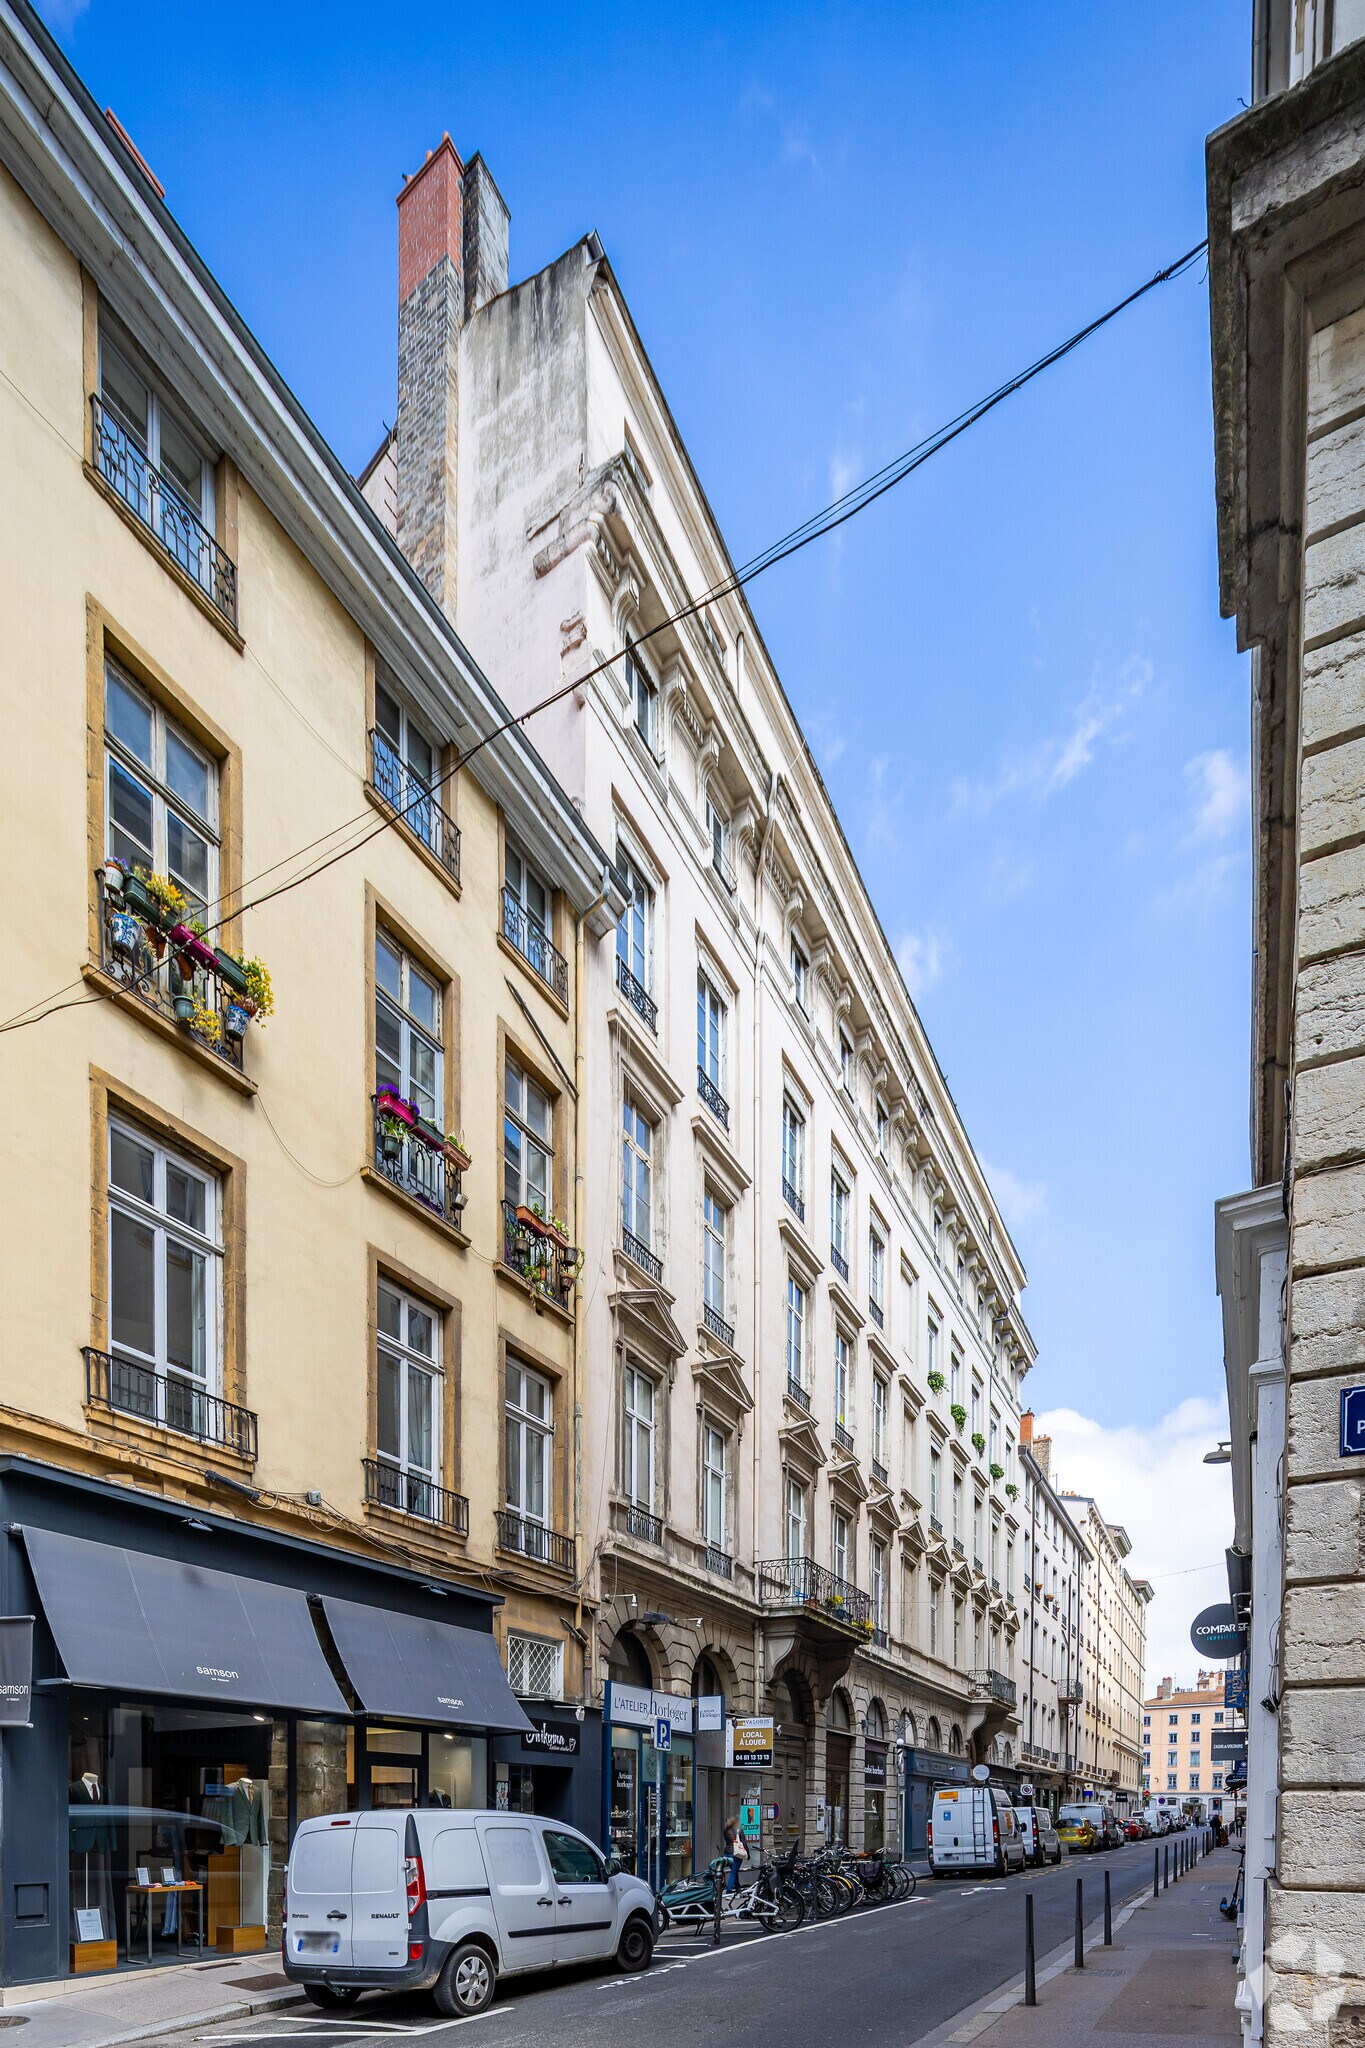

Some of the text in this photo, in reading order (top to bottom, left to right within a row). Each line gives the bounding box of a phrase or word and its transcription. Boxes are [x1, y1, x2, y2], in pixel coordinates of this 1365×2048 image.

[196, 1666, 239, 1679] samson
[0, 1685, 29, 1695] samson
[614, 1697, 648, 1714] L'ATELIER
[739, 1738, 767, 1746] À LOUER
[617, 1772, 633, 1780] Artisan
